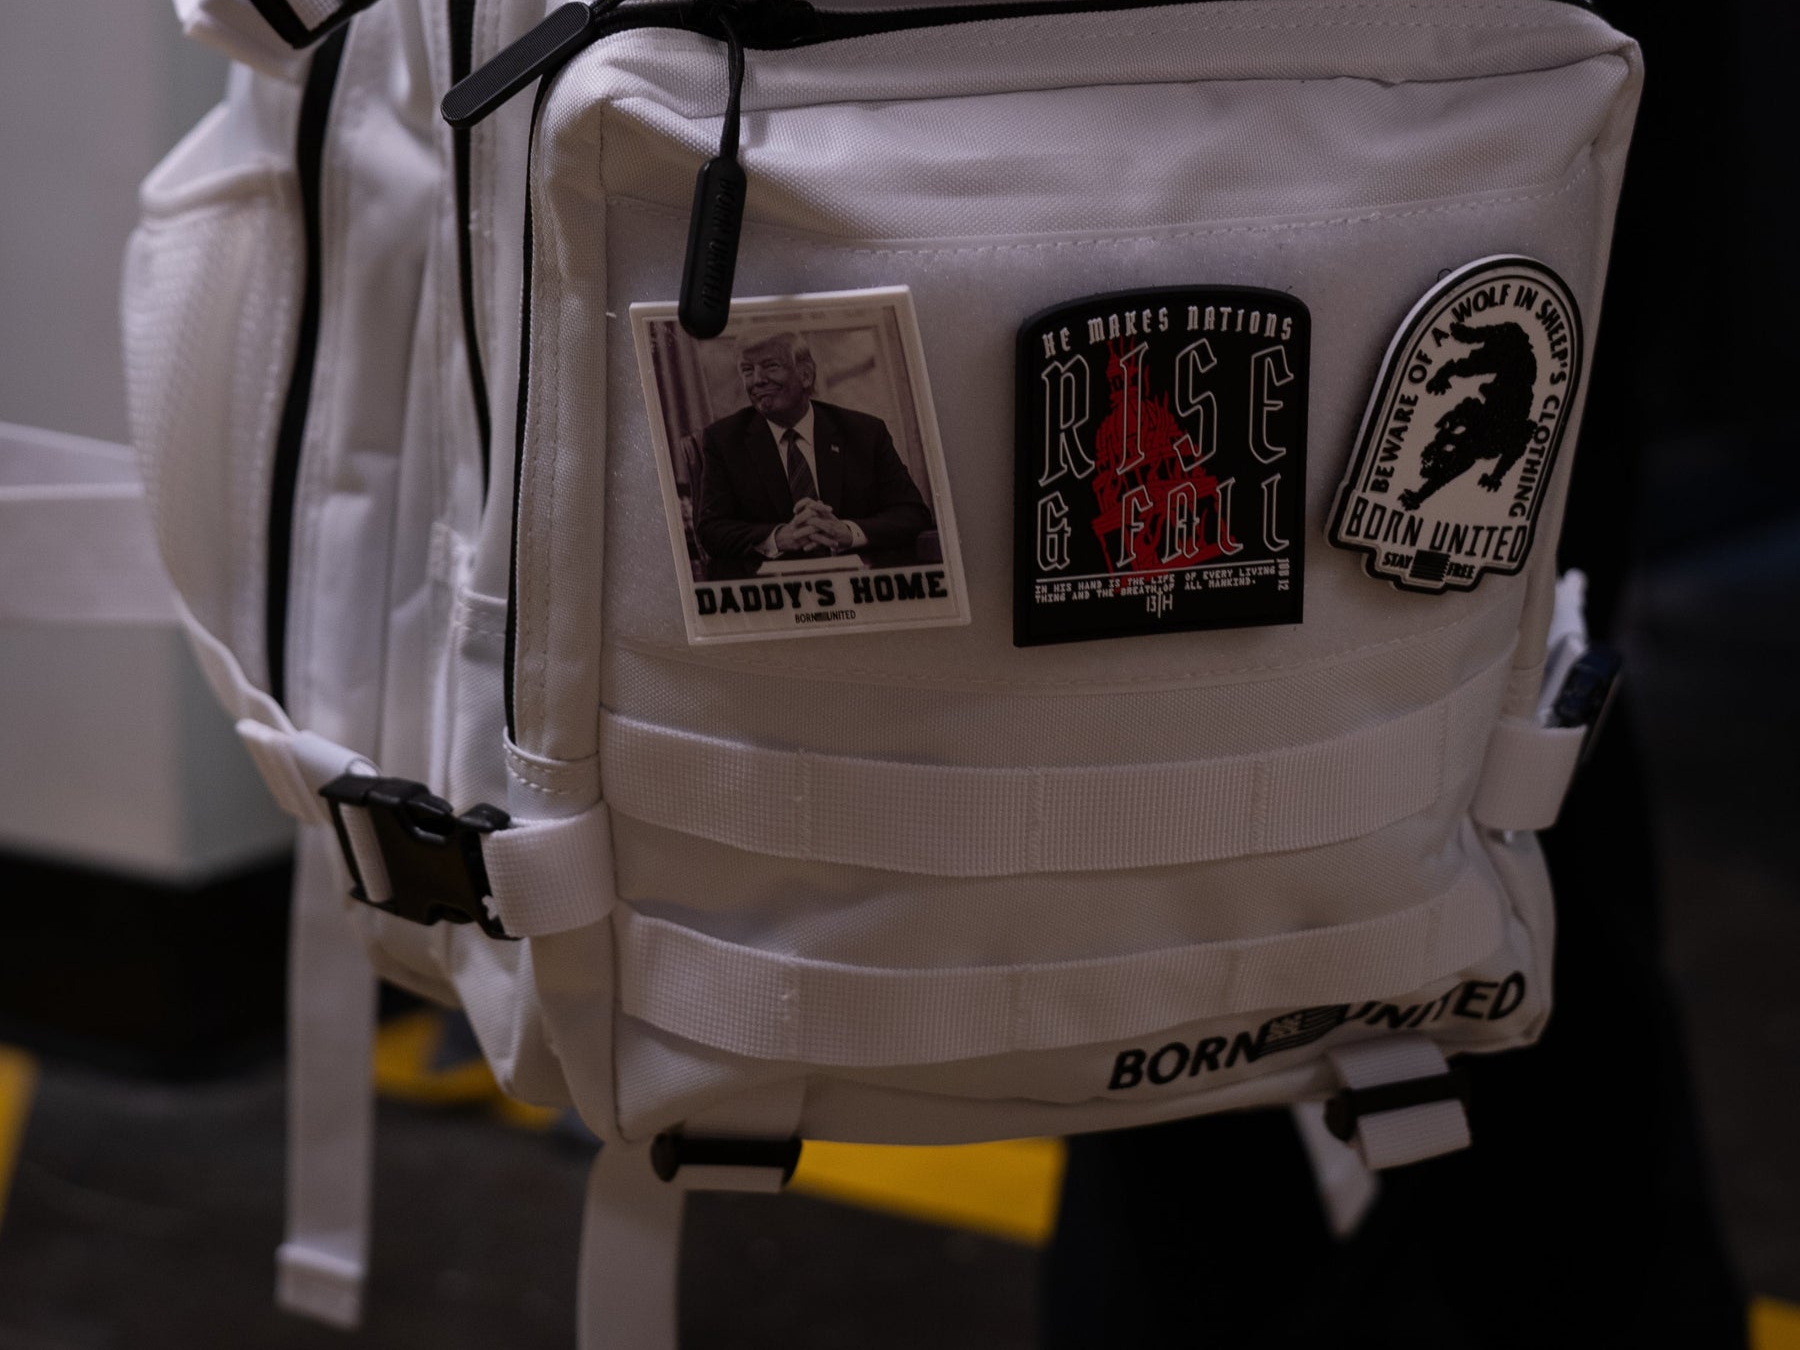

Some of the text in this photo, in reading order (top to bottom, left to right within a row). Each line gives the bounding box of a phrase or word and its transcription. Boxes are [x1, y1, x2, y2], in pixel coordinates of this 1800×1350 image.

[1042, 305, 1293, 359] HE MAKES NATIONS
[1038, 338, 1294, 487] RISE
[1369, 283, 1567, 518] BEWARE OF A WOLF IN SHEEP'S CLOTHING
[1117, 473, 1290, 568] FALL
[1346, 496, 1527, 563] BORN UNITED
[695, 570, 948, 615] DADDY'S HOME
[1071, 590, 1090, 601] AND
[1096, 587, 1115, 599] THE
[1183, 580, 1203, 591] ALL
[1077, 579, 1102, 591] HAND
[1127, 575, 1145, 586] THE
[1151, 573, 1175, 585] LIFE
[1202, 568, 1234, 581] EVERY
[1239, 565, 1276, 577] LIVING
[1382, 552, 1476, 579] STAY FREE
[795, 609, 857, 624] BORN UNITED
[1108, 1029, 1264, 1091] BORN
